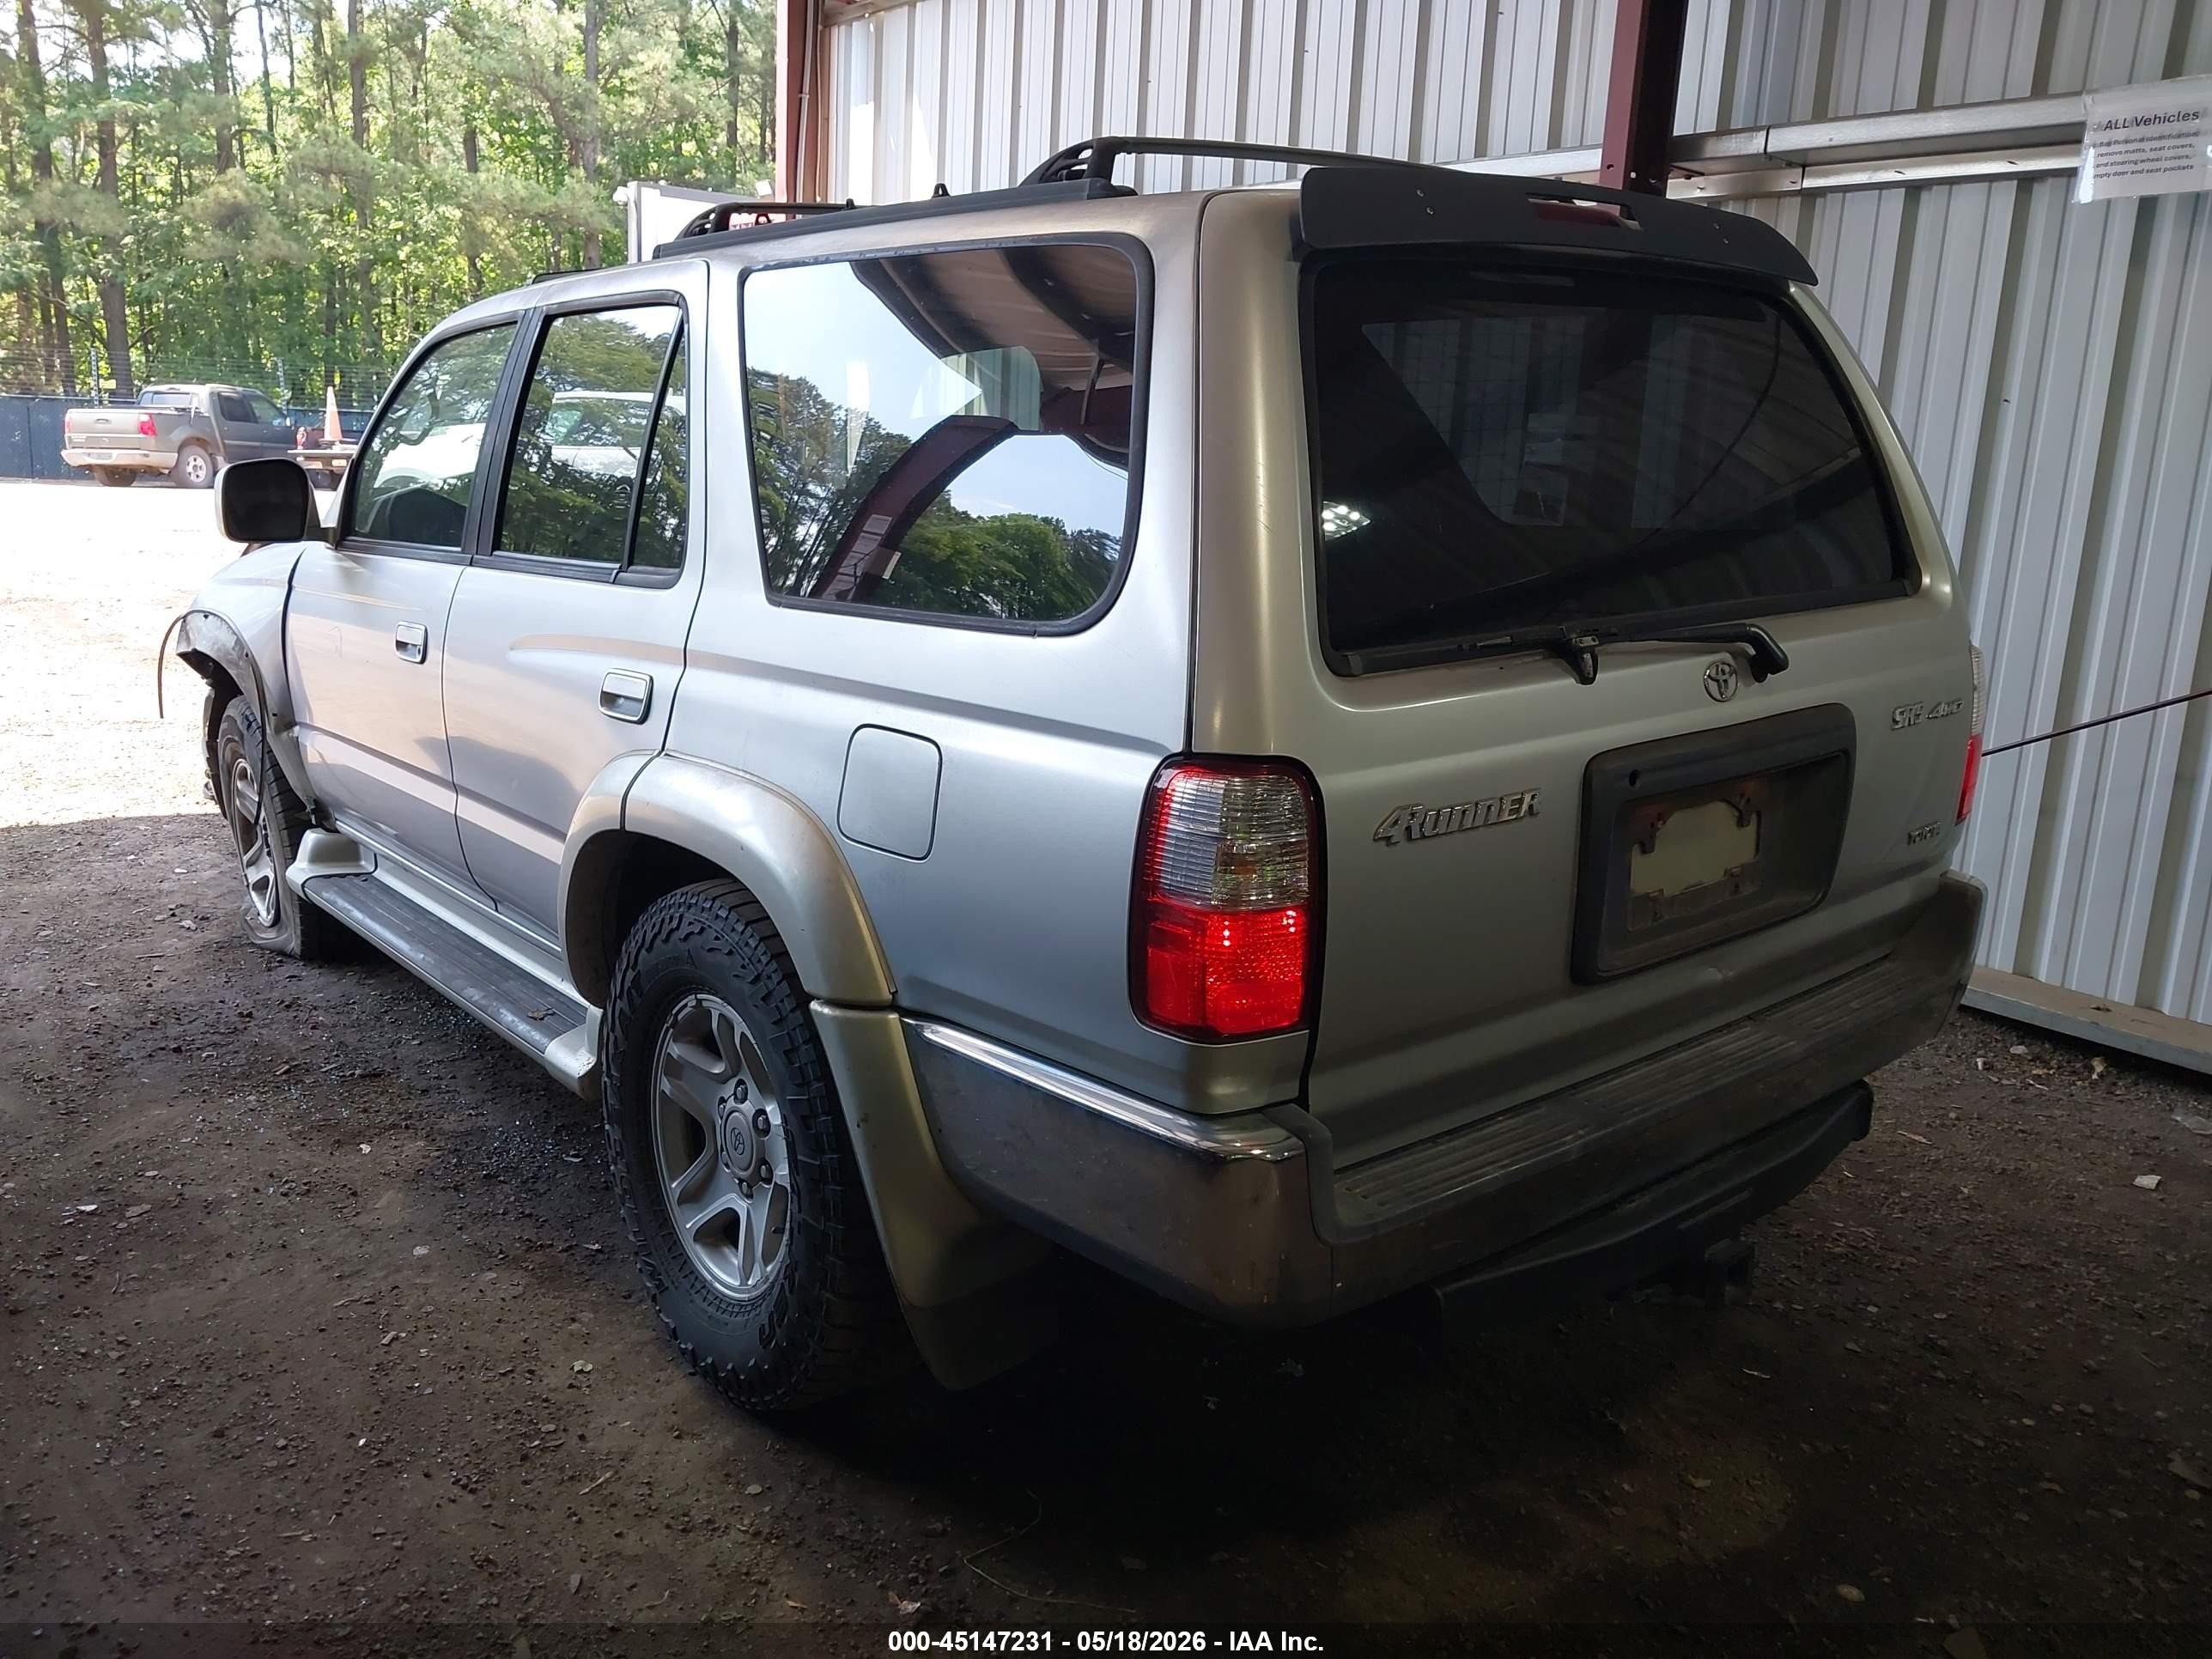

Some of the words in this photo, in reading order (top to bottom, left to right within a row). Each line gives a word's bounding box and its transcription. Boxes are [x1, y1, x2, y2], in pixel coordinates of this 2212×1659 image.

[2104, 118, 2130, 131] ALL
[2134, 110, 2200, 127] Vehicles
[2096, 160, 2109, 168] and
[2110, 157, 2138, 167] steering
[2139, 155, 2163, 164] wheel
[2094, 171, 2112, 180] mpty
[2162, 163, 2194, 173] pockets
